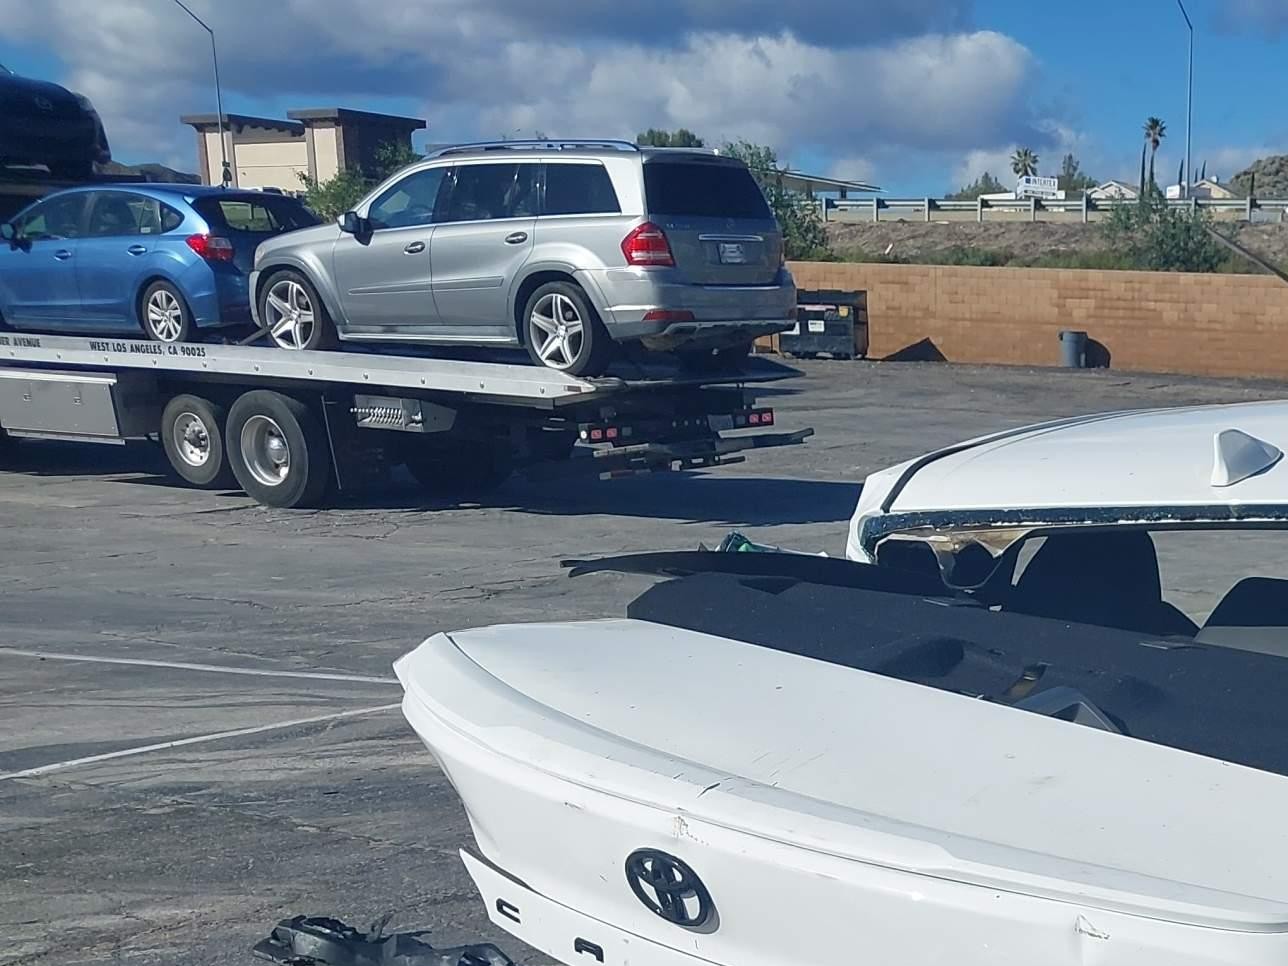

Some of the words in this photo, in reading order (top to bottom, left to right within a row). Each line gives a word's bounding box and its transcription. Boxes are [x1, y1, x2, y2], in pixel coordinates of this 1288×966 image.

[14, 337, 41, 348] AVENUE
[89, 341, 110, 352] WEST
[112, 343, 127, 353] LOS
[130, 344, 165, 356] ANGELES,
[168, 345, 178, 355] CA
[180, 346, 206, 357] 90025
